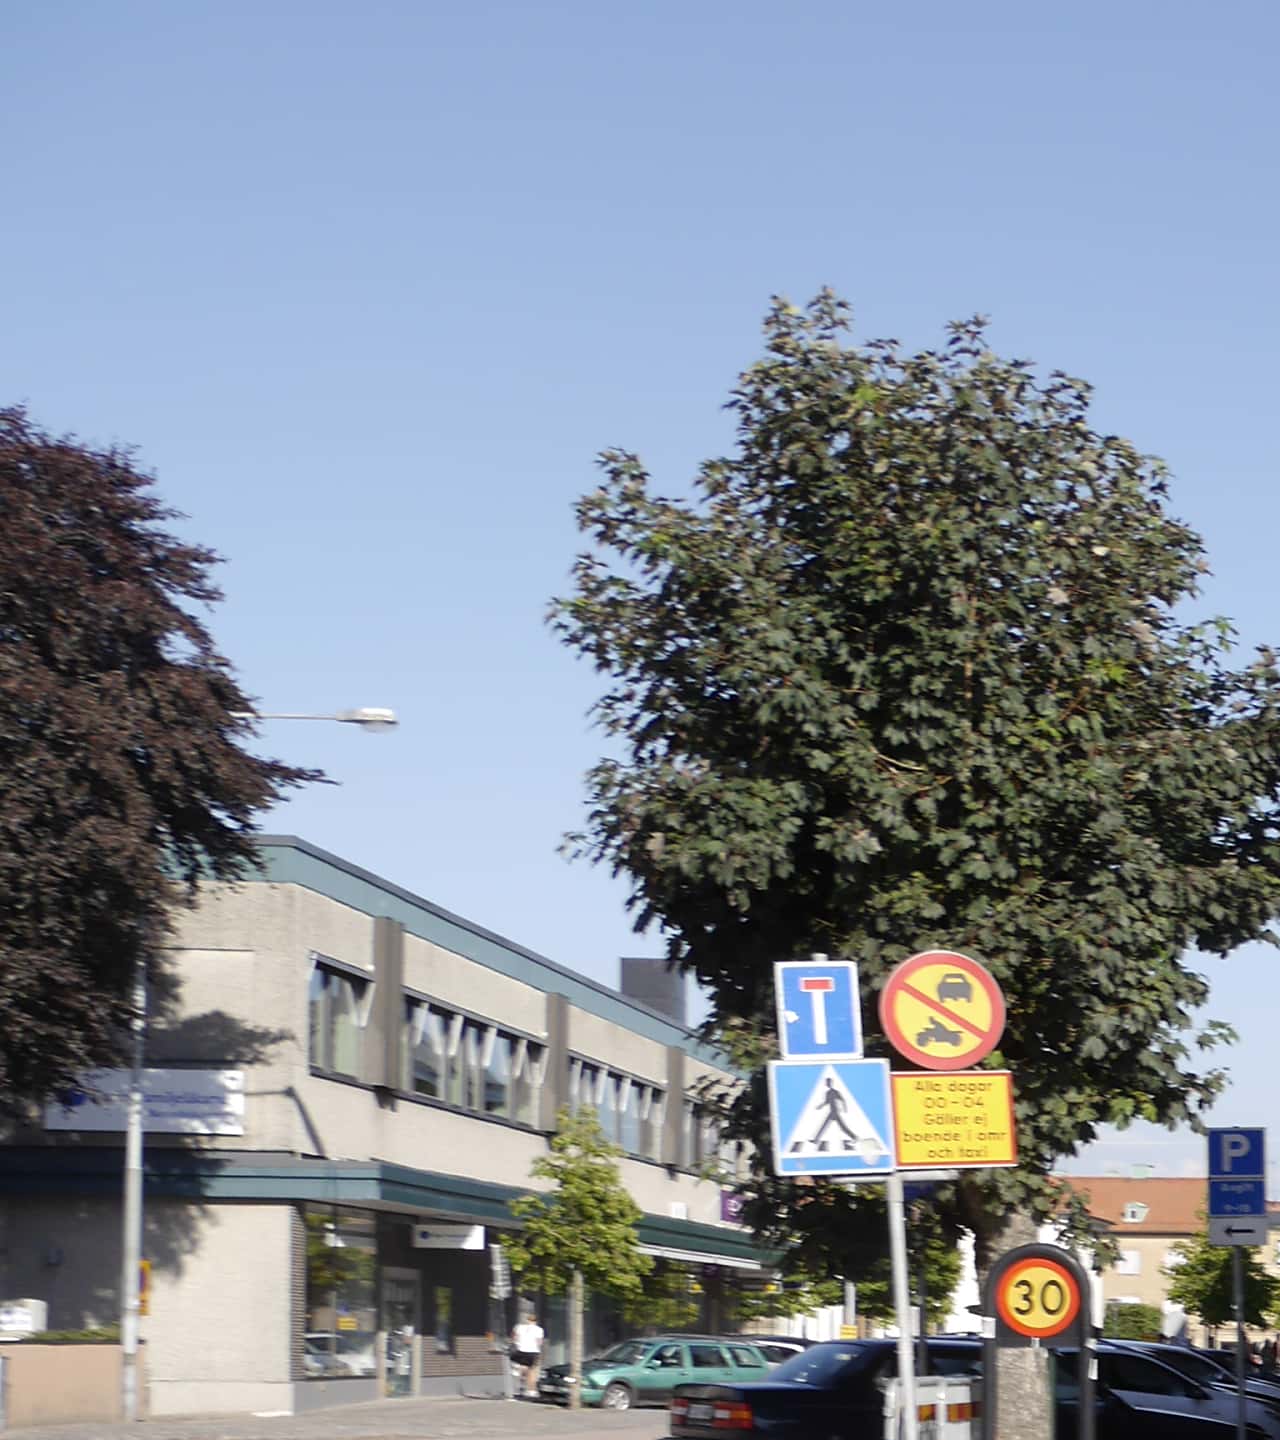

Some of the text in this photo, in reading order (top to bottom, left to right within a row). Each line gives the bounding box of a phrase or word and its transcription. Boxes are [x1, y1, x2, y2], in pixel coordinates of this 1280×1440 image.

[914, 1081, 992, 1095] Alla dagar
[923, 1113, 988, 1127] Gäller ej
[903, 1130, 960, 1142] boende
[927, 1146, 988, 1158] och taxi
[1222, 1134, 1251, 1172] P
[1013, 1280, 1064, 1316] 30
